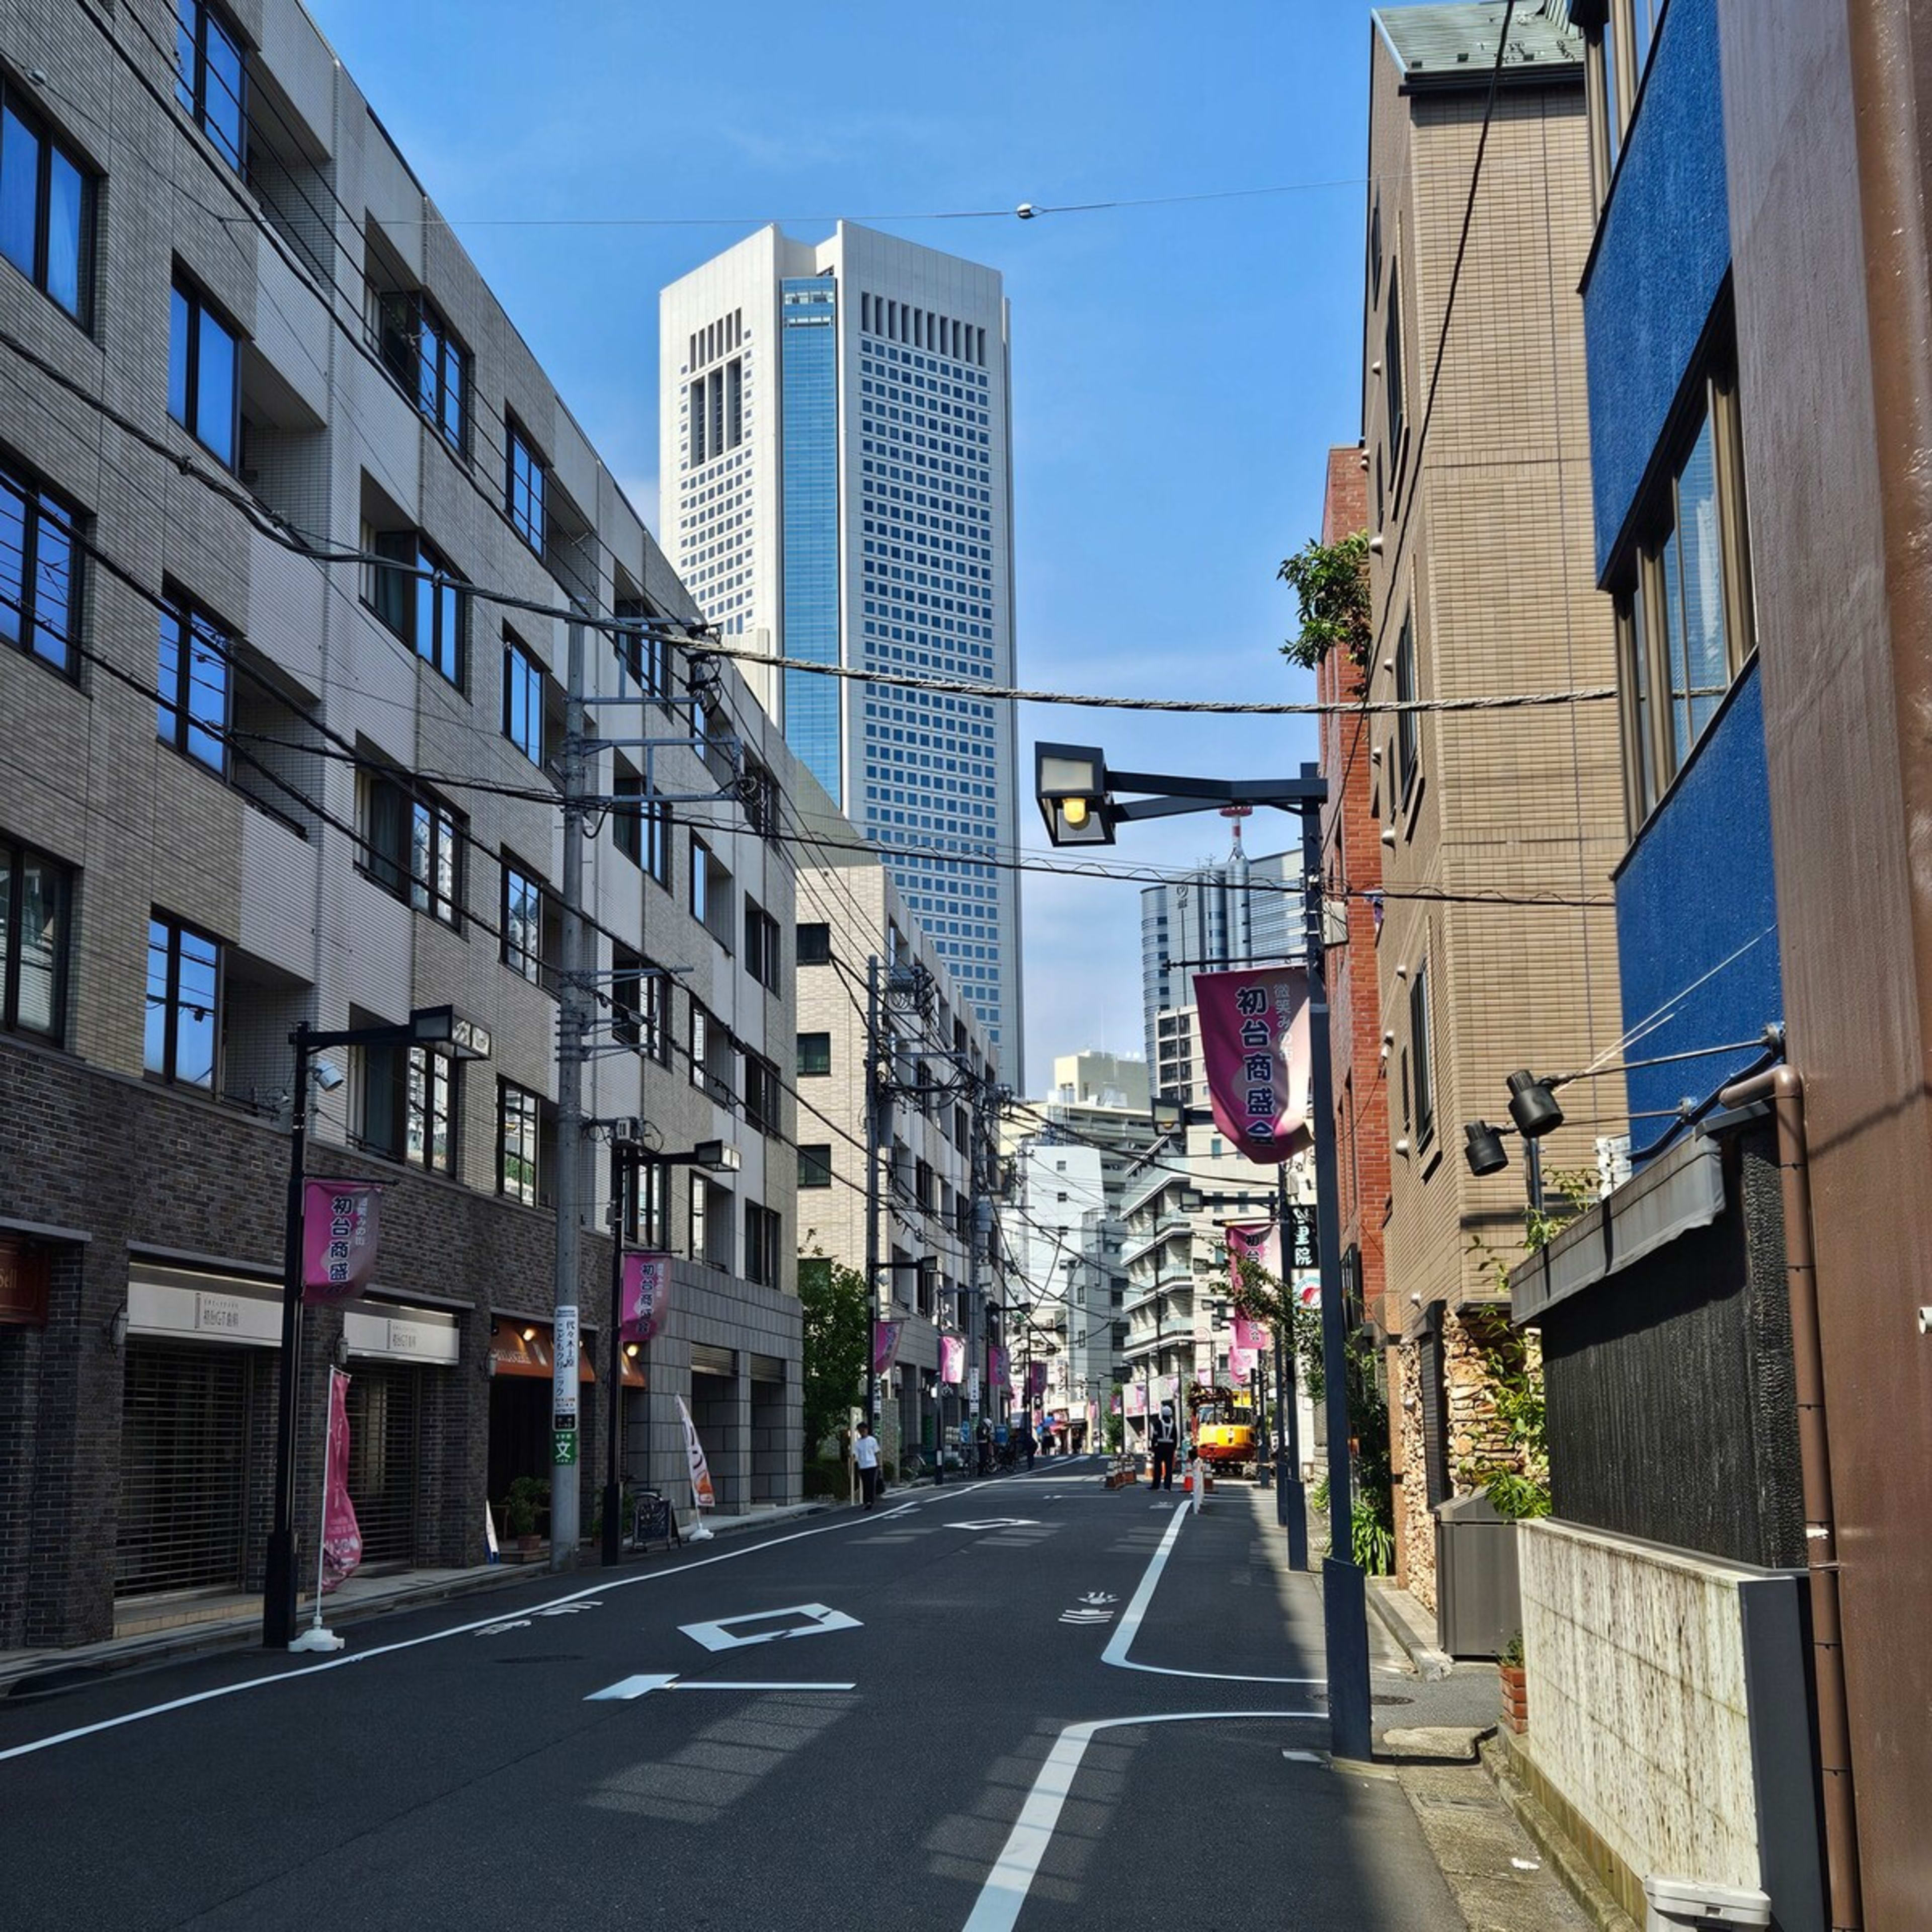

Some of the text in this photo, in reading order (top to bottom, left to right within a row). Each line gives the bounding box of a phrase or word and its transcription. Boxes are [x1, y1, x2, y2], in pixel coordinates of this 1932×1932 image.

[1236, 987, 1276, 1148] 初台商盛会
[555, 1440, 571, 1460] 文
